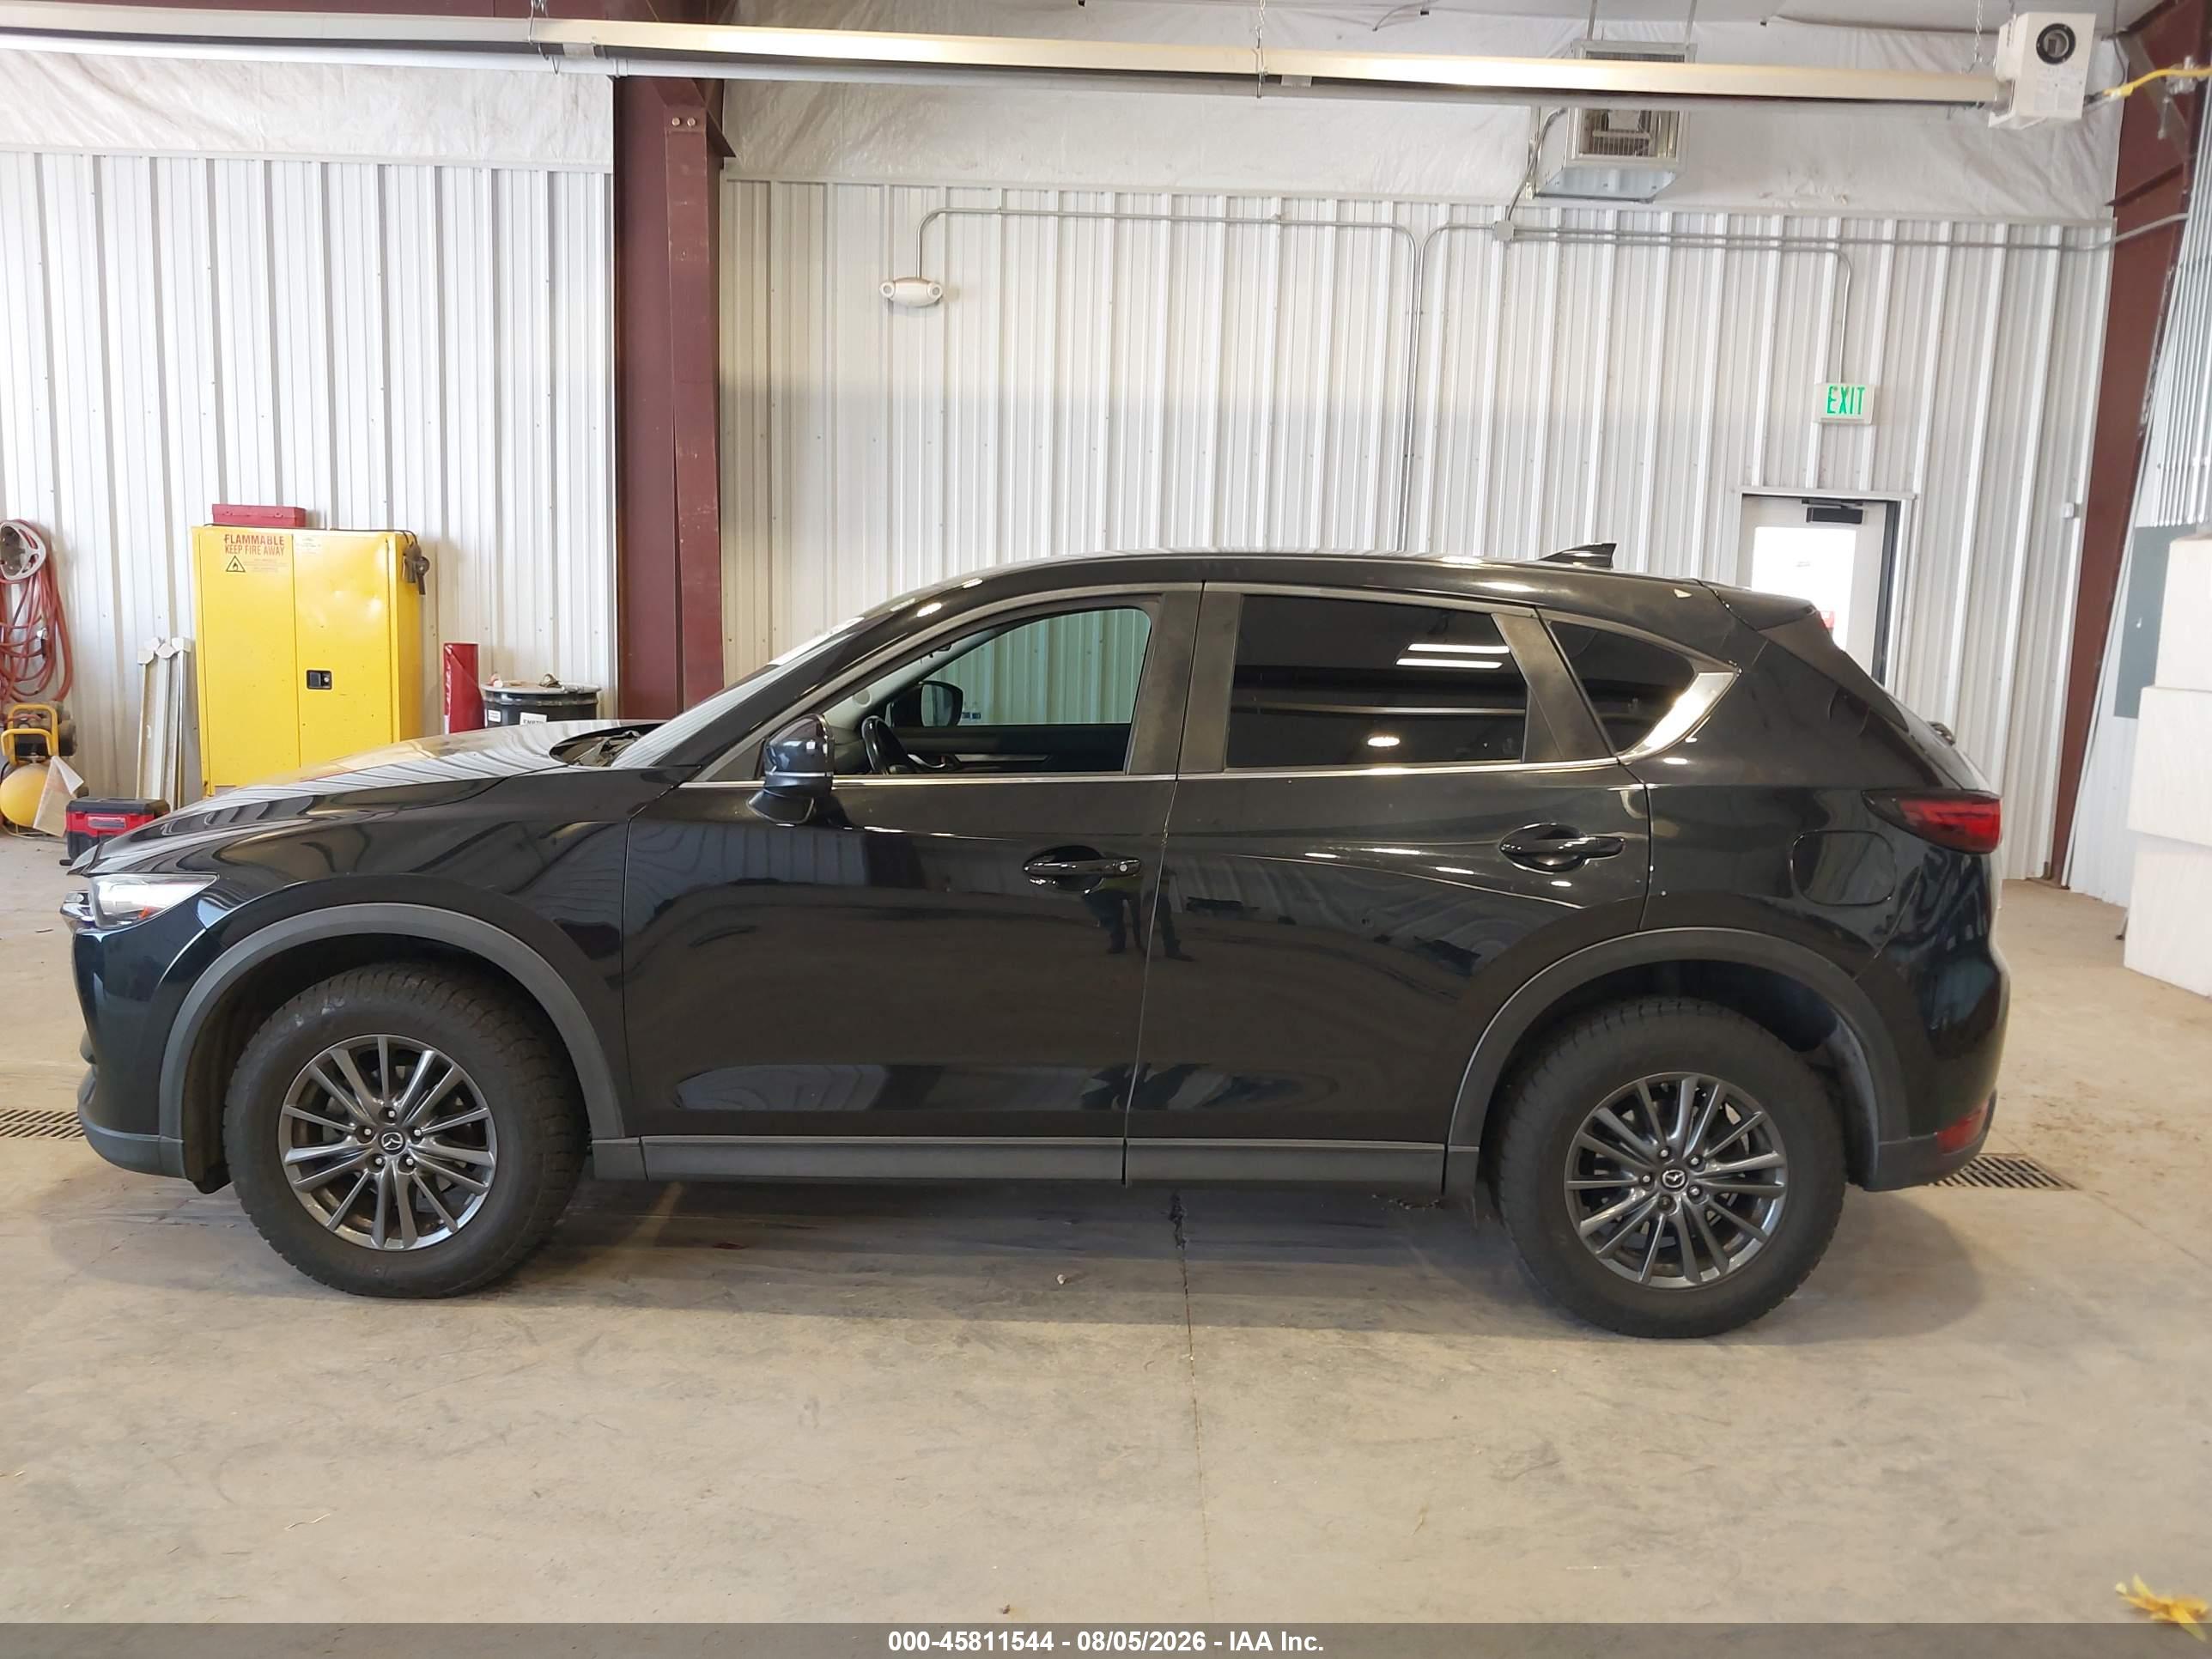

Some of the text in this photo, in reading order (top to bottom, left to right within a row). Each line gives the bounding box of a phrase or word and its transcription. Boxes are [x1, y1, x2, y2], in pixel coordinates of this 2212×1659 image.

[1827, 386, 1865, 415] EXIT
[225, 534, 284, 545] FLAMMABLE
[226, 544, 242, 554] KEEP
[245, 545, 261, 556] FIRE
[264, 546, 284, 556] AWAY
